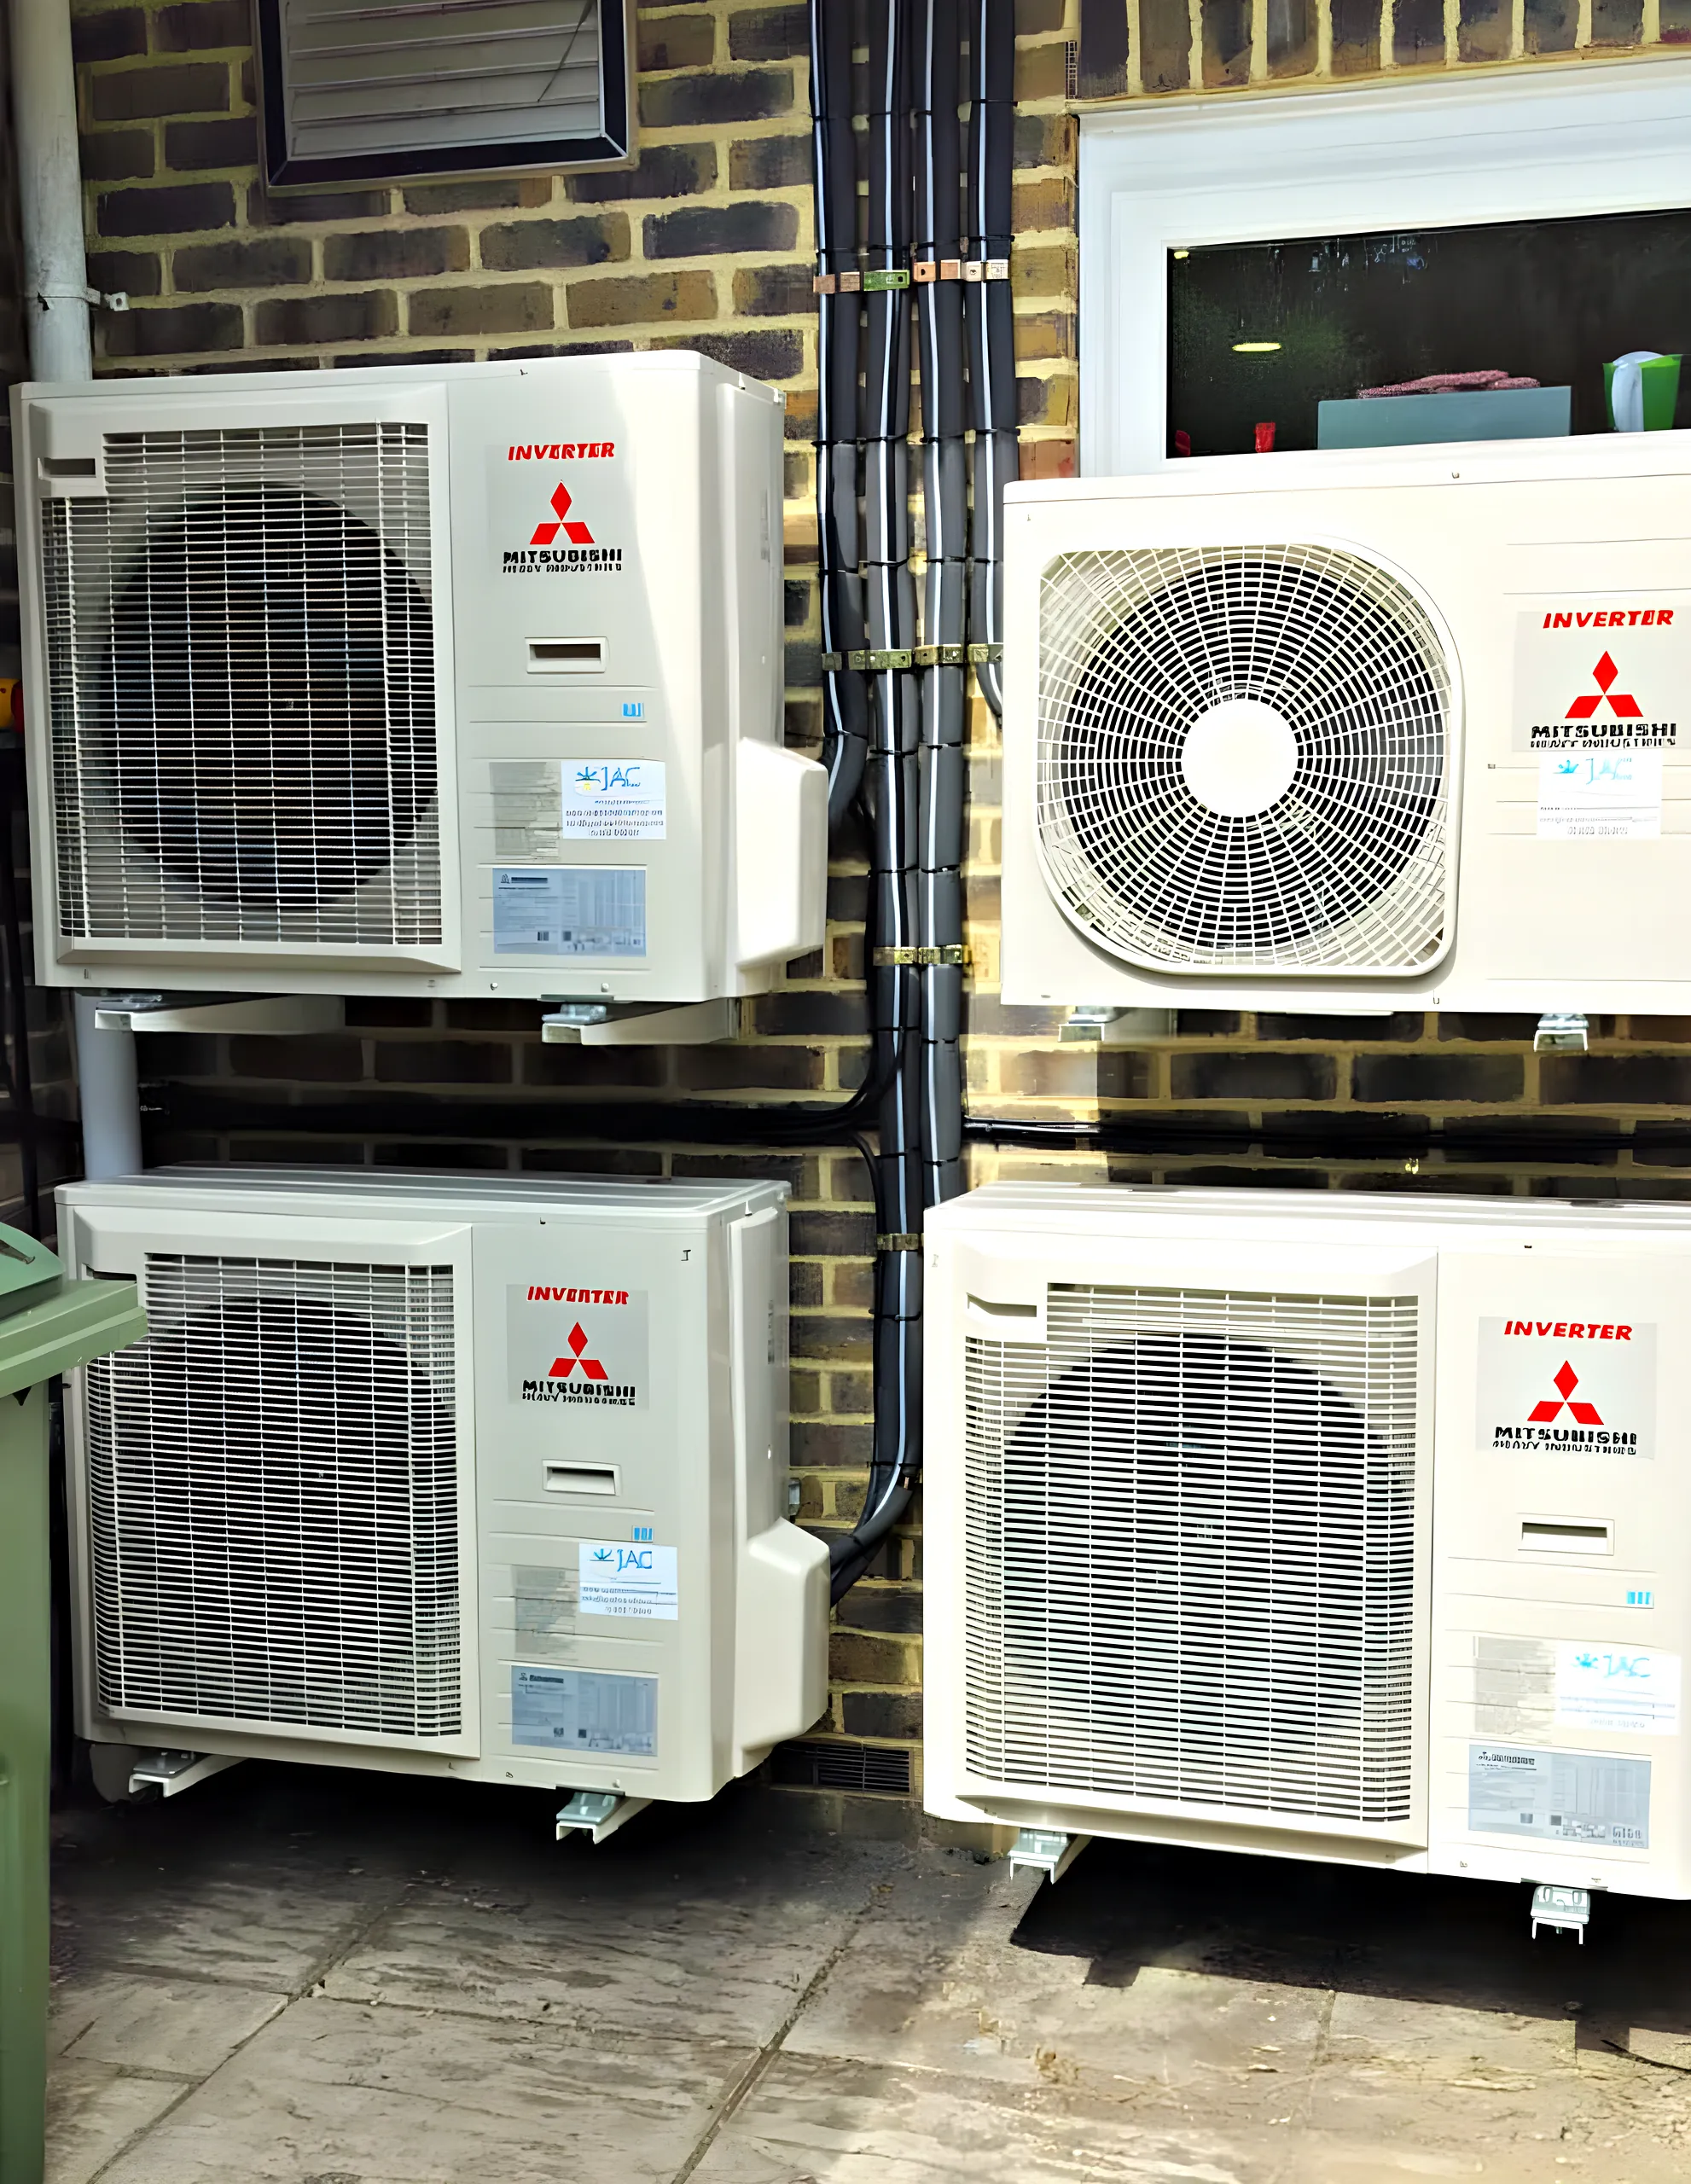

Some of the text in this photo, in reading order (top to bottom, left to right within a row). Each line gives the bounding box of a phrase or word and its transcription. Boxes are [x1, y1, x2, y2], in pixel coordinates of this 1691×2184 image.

[508, 442, 615, 461] INVERTER
[503, 549, 622, 563] MITSUBISHI
[1543, 609, 1674, 629] INVERTER
[1531, 723, 1676, 739] MITSUBISHI
[527, 1286, 629, 1304] INVERTER
[1504, 1321, 1633, 1340] INVERTER
[1495, 1426, 1637, 1445] MITSUBISHI
[617, 1548, 653, 1572] JAC
